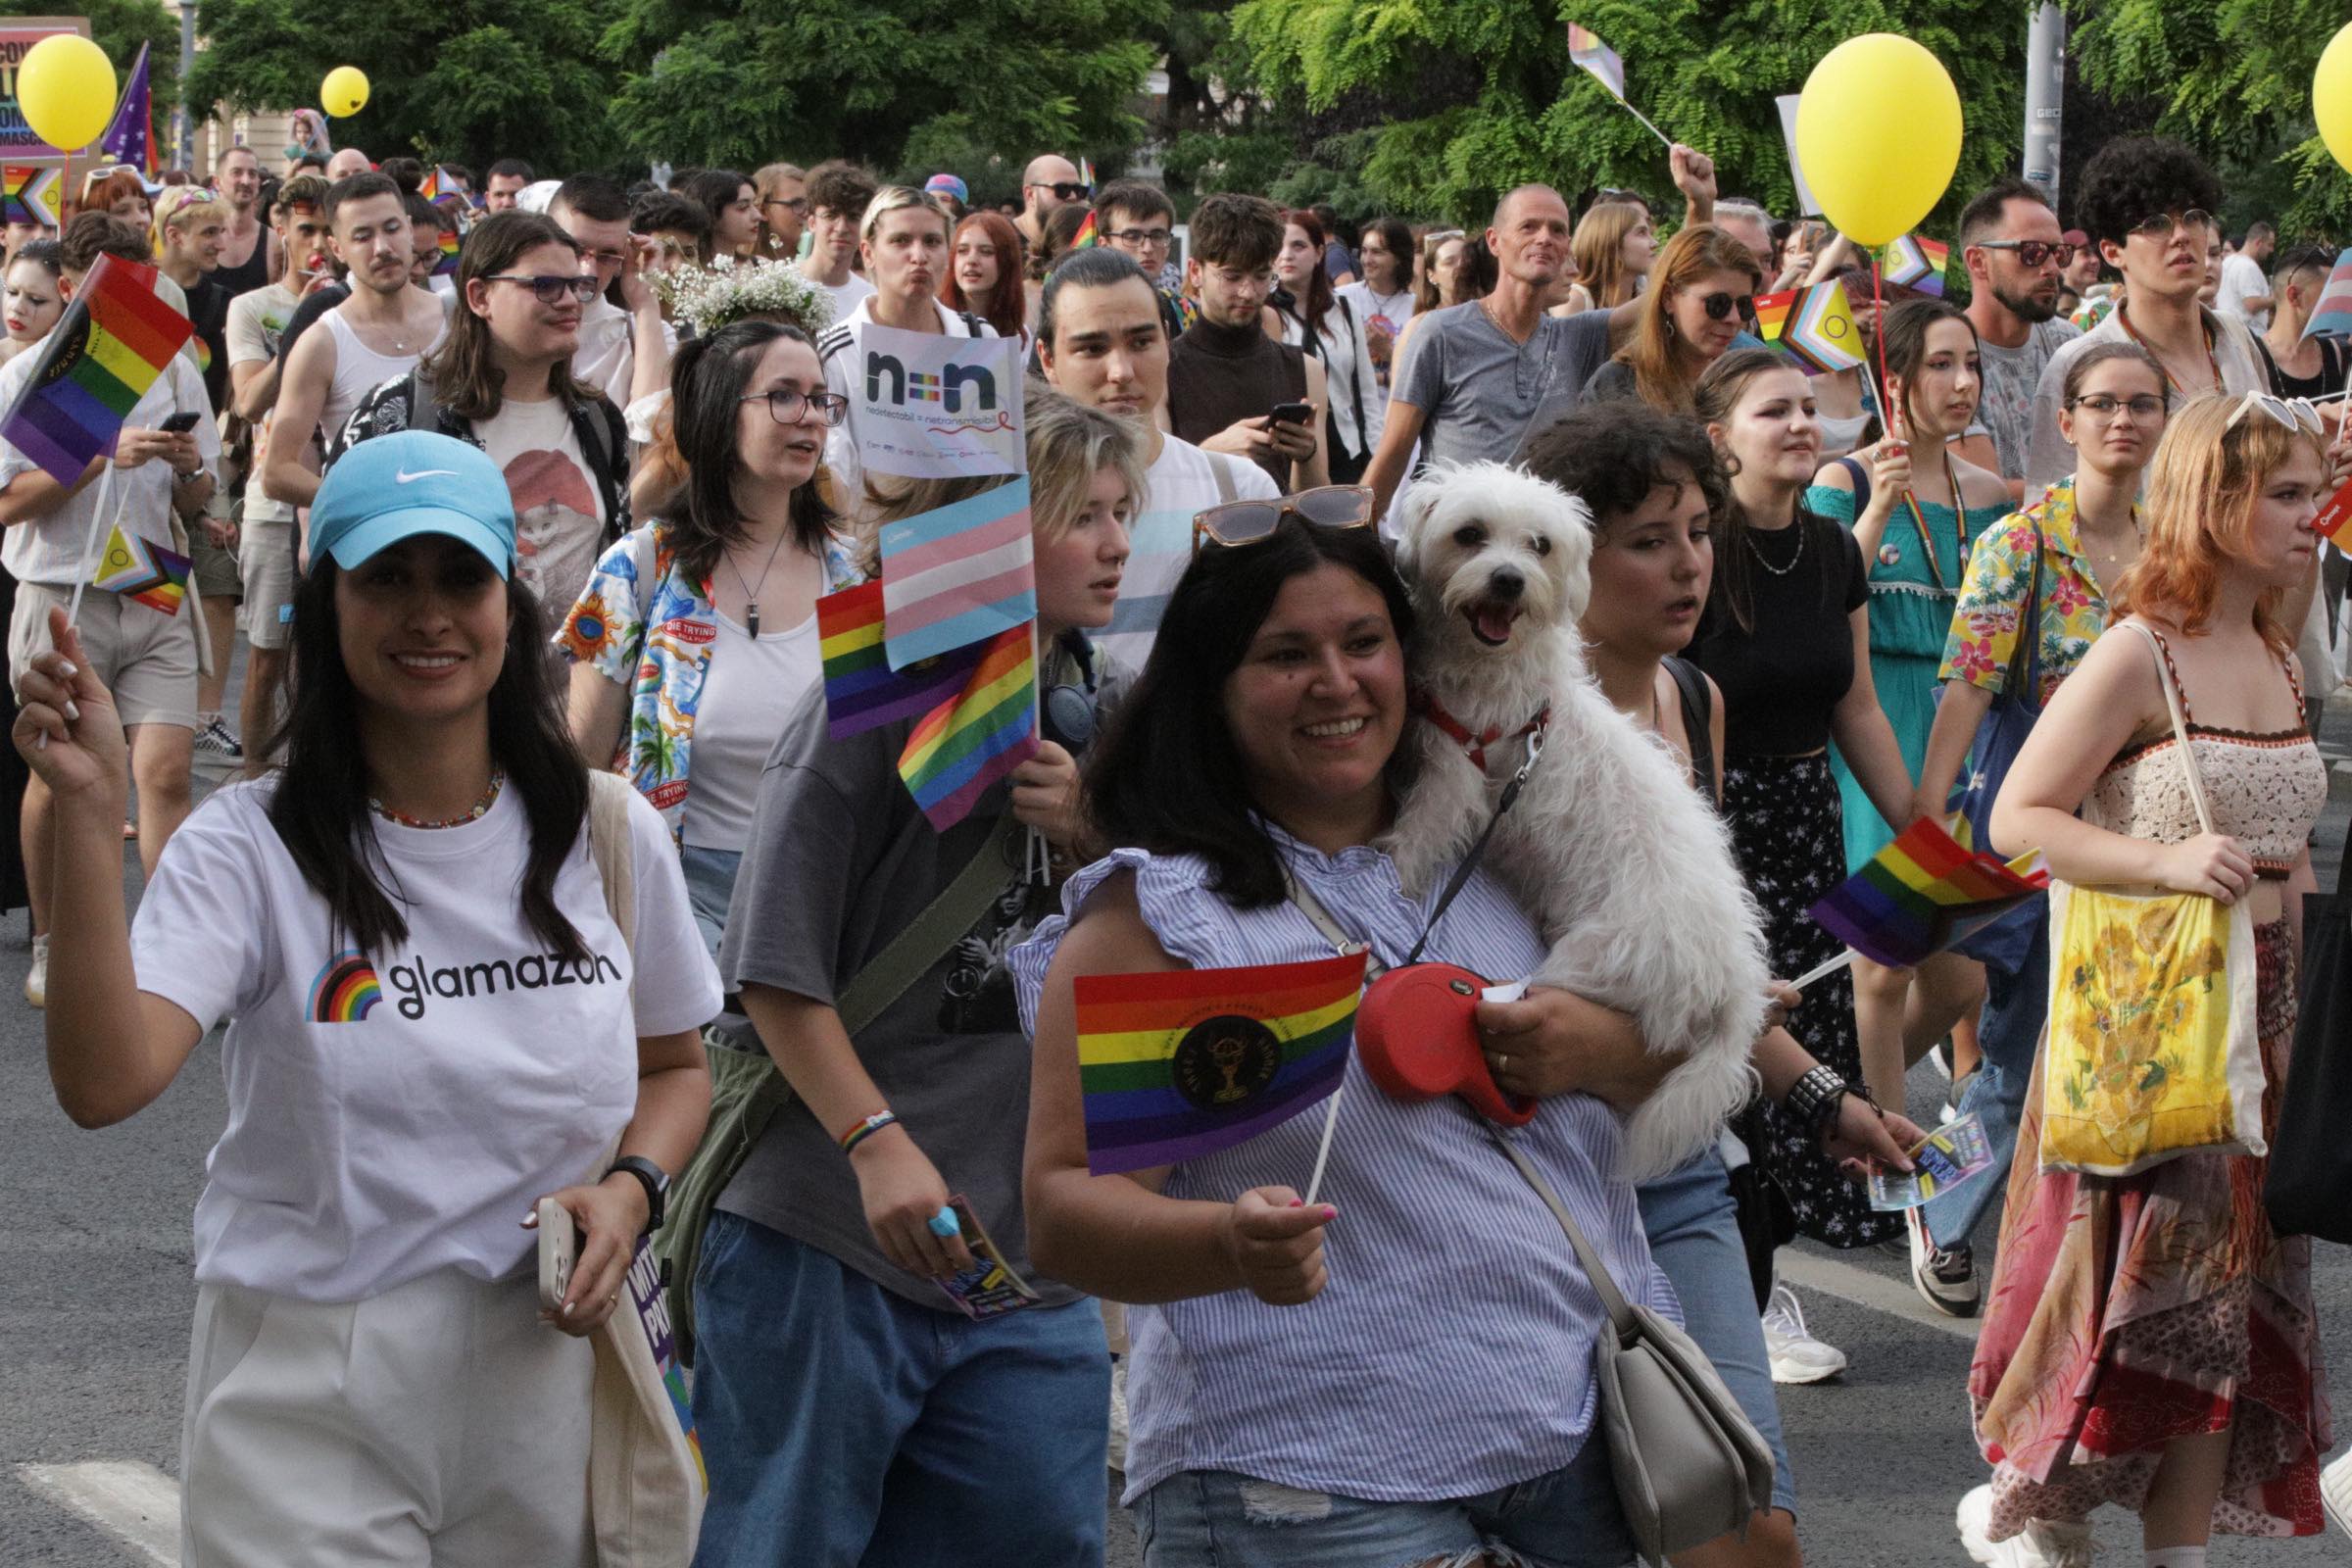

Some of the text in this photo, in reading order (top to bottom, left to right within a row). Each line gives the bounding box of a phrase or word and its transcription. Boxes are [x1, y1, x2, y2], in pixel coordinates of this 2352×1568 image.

[865, 405, 915, 422] nedetectabil
[666, 621, 715, 636] DIE TRYING
[389, 955, 622, 1020] glamazon
[643, 1289, 670, 1348] PRI
